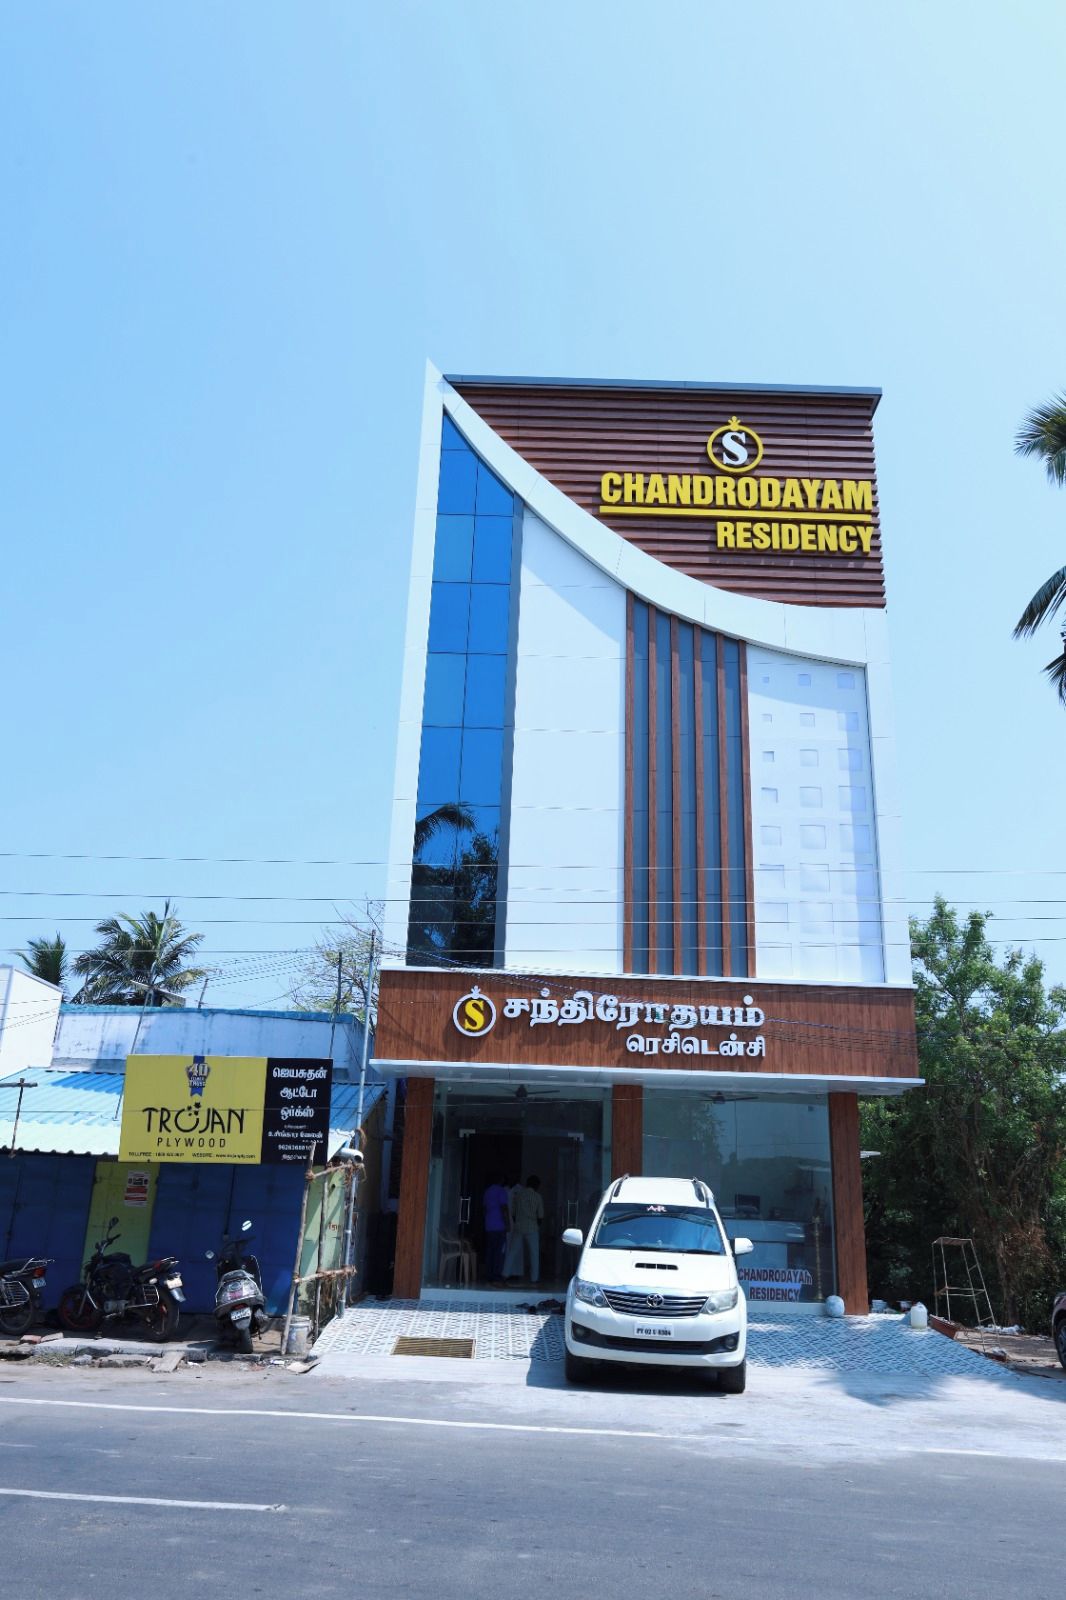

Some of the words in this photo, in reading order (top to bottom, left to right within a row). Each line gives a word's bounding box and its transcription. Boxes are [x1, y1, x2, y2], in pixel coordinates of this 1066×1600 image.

[721, 431, 749, 466] S
[601, 472, 874, 512] CHANDRODAYAM
[716, 521, 875, 554] RESIDENCY
[463, 999, 485, 1031] S
[503, 987, 766, 1030] சந்திரோதயம்
[626, 1032, 766, 1057] ரெசிடென்சி
[280, 1085, 317, 1099] ஆட்டோ
[142, 1103, 247, 1134] TROJAN
[157, 1137, 226, 1148] PLYWOOD
[749, 1286, 800, 1302] RESIDENCY
